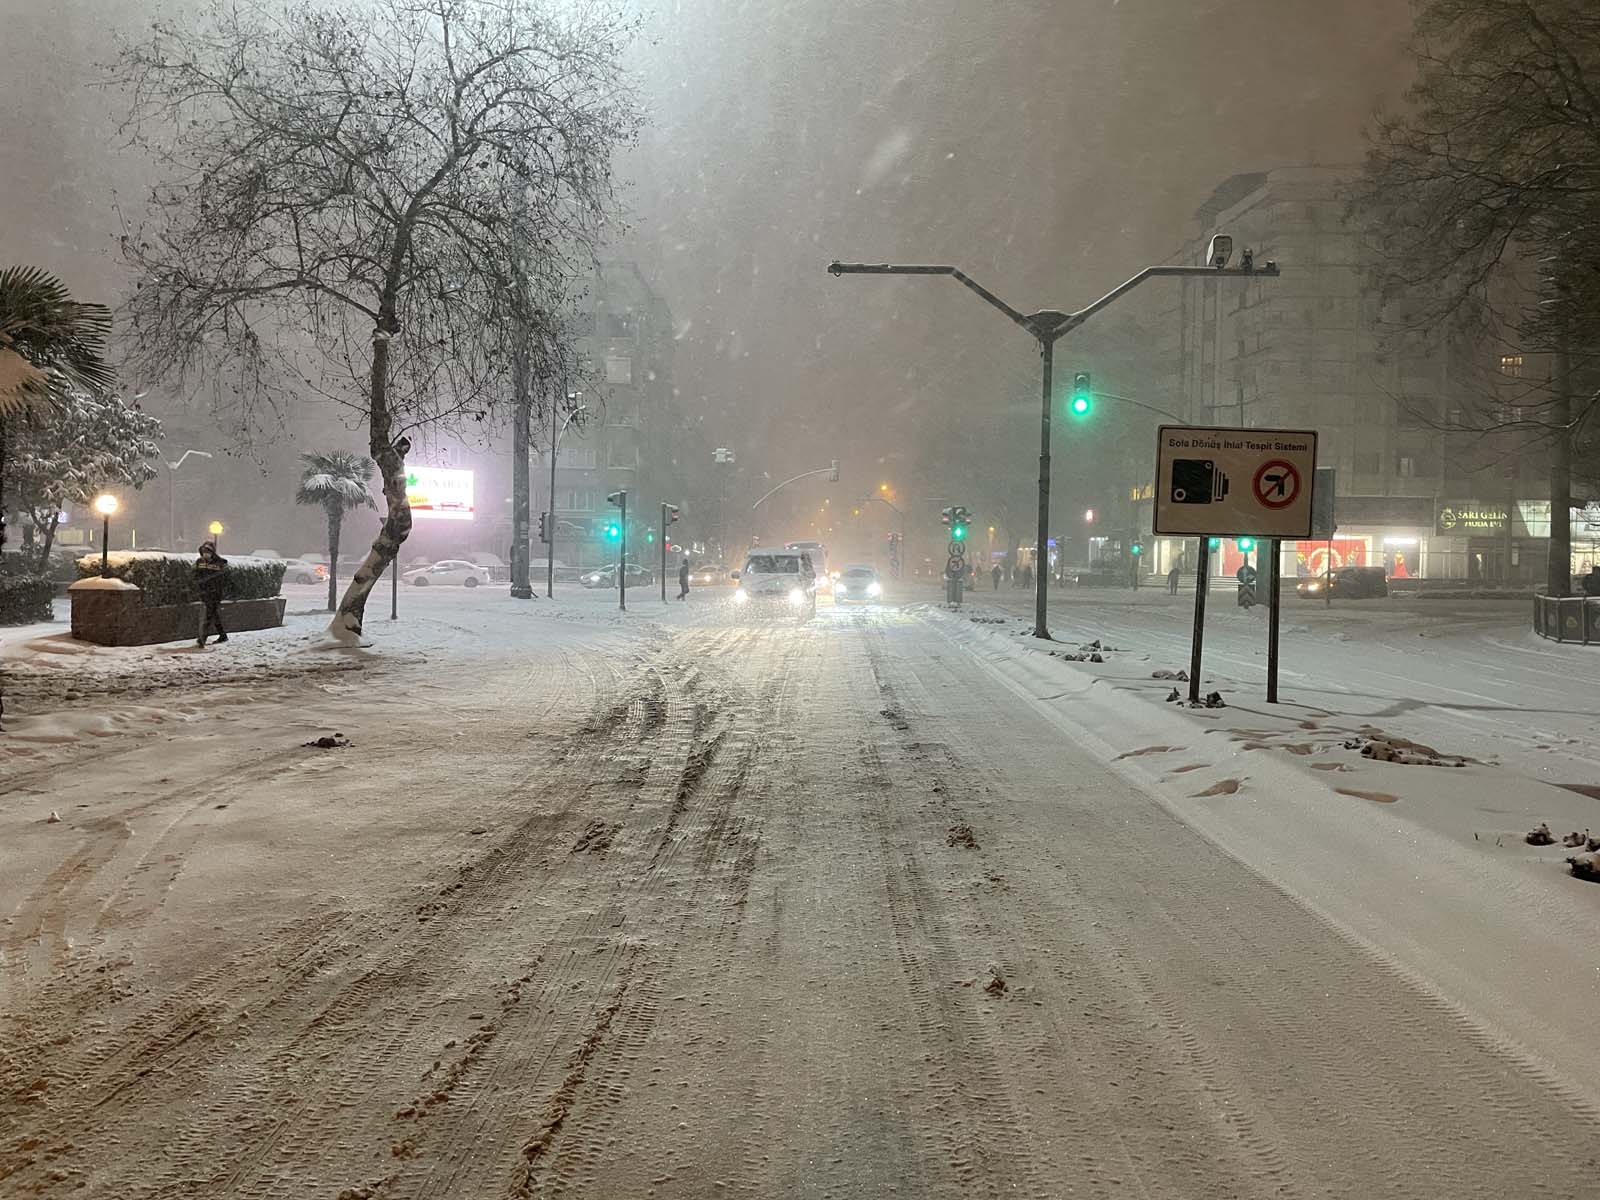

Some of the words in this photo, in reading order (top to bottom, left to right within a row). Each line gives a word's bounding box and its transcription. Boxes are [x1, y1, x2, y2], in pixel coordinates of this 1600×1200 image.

[1168, 438, 1189, 448] Sola
[1247, 440, 1272, 452] Tespit
[1274, 441, 1308, 452] Sistemi
